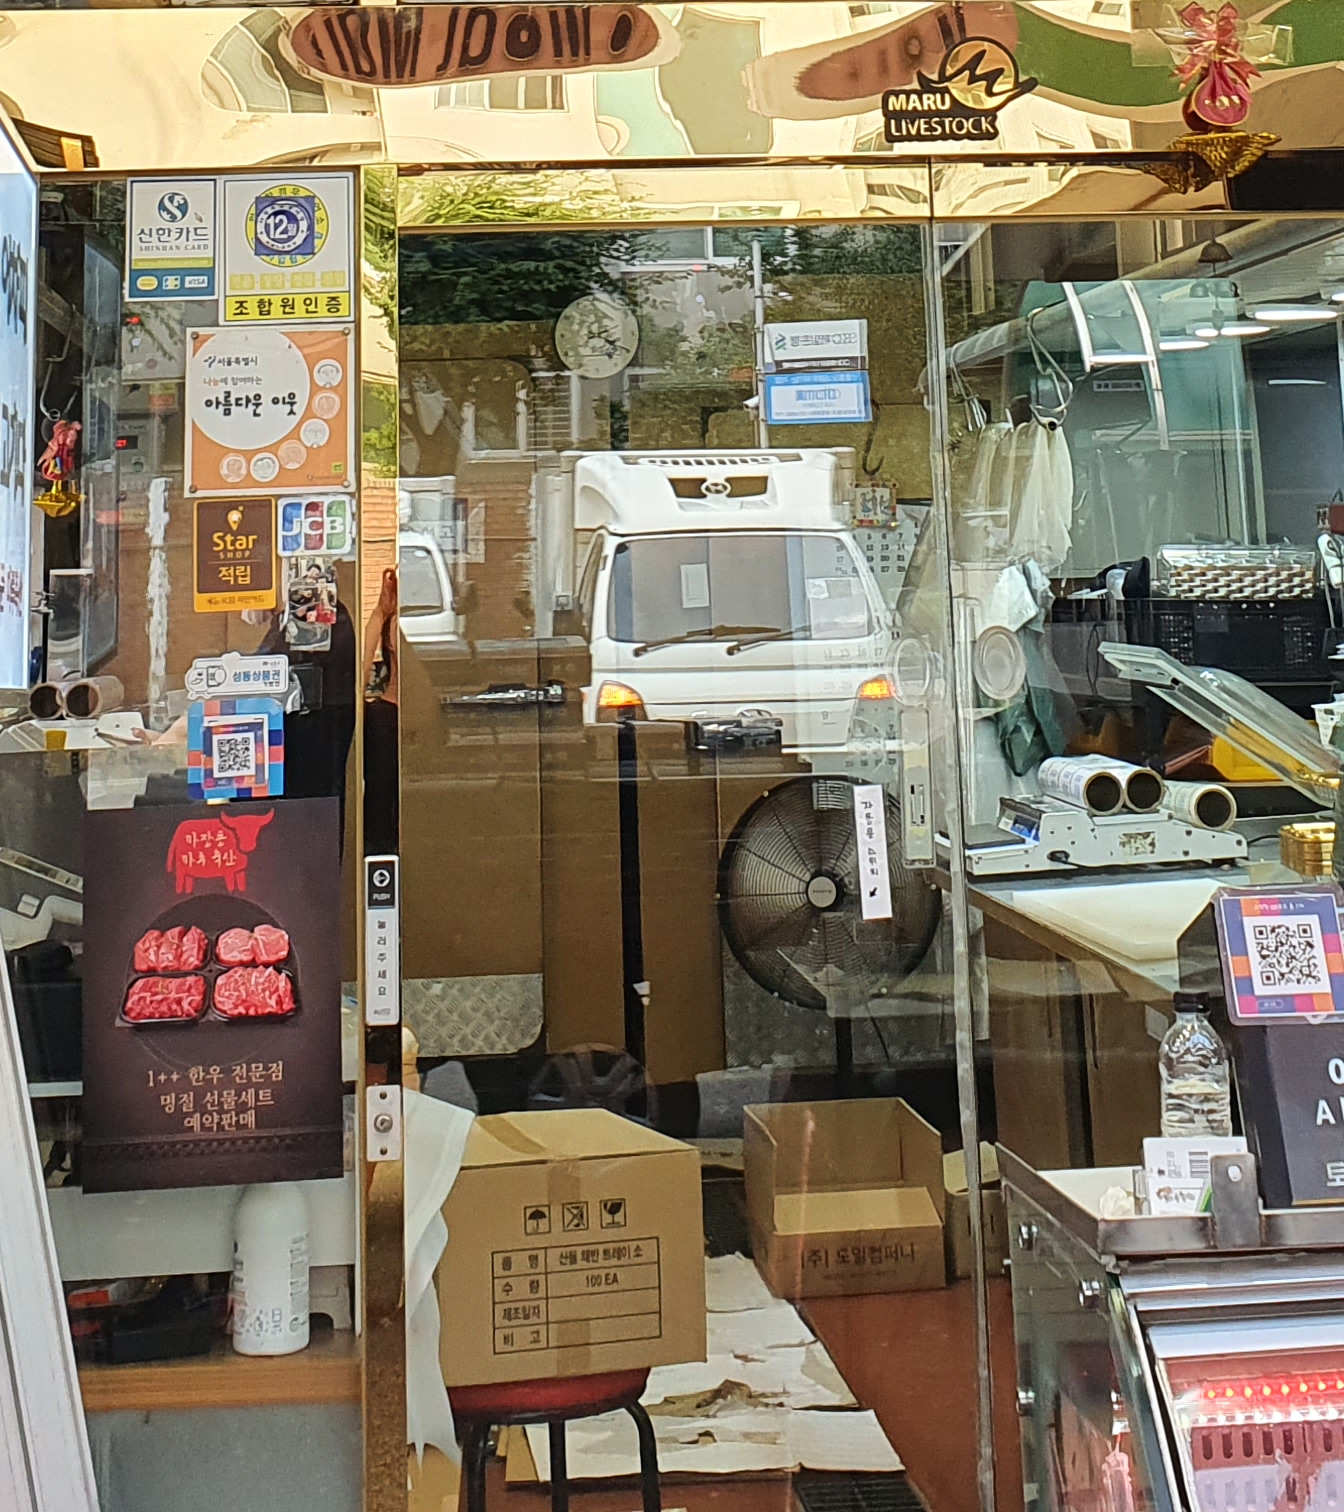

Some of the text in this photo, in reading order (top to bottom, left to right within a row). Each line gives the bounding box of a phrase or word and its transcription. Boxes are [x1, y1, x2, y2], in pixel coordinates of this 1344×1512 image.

[887, 91, 953, 115] MARU
[890, 116, 997, 139] LIVESTOCK
[137, 226, 210, 244] 신한카드
[138, 244, 210, 253] SHINHAN CARD
[187, 278, 207, 286] VISA
[233, 295, 342, 317] 조합원인증
[217, 356, 258, 367] 서울특별시
[204, 390, 298, 418] 아름다운 이웃
[282, 516, 345, 536] JCB
[212, 531, 258, 552] Star
[219, 551, 251, 559] SHOP
[218, 565, 251, 585] 적립
[232, 670, 281, 683] 성동상품권
[372, 892, 391, 900] PUSH
[376, 919, 388, 997] 눌러주세요
[373, 1007, 391, 1016] AUTO
[146, 1060, 284, 1087] 1++ 한우 전문점
[160, 1088, 275, 1113] 명절 선물세트
[183, 1110, 256, 1133] 예약판매
[1315, 1100, 1335, 1126] A
[585, 1273, 603, 1288] 100
[604, 1272, 619, 1286] EA
[502, 1305, 541, 1323] 제조일자
